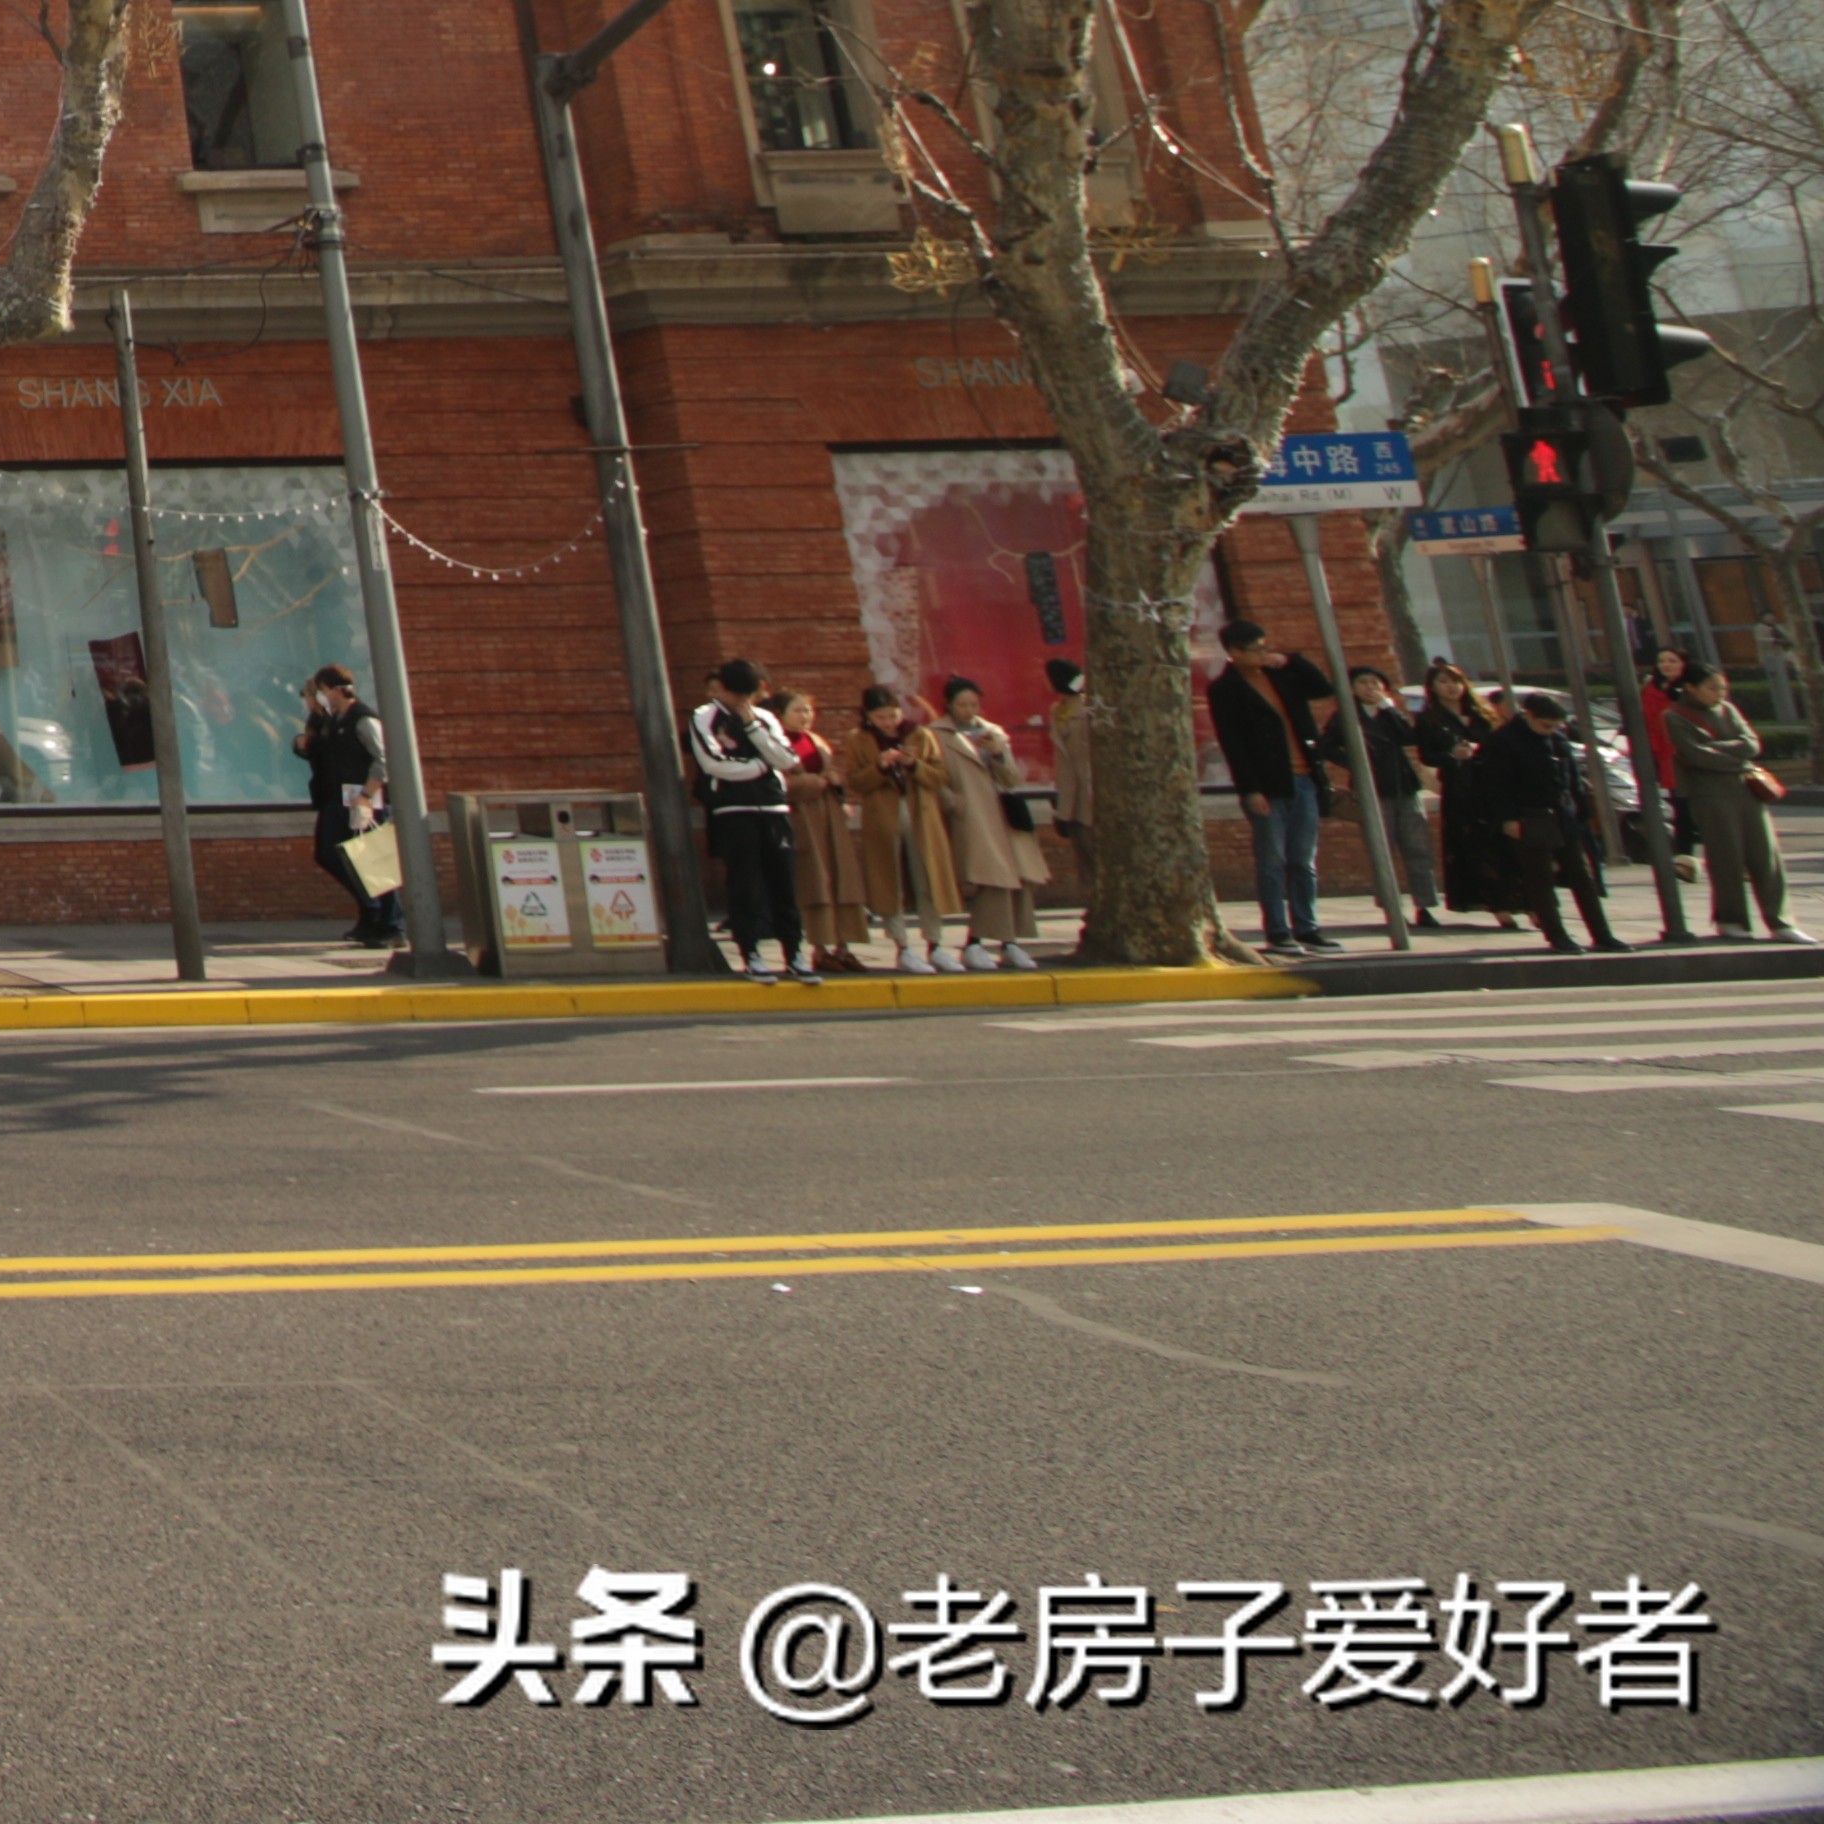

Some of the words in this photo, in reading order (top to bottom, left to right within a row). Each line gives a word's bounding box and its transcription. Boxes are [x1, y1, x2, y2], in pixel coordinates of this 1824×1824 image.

[161, 378, 223, 407] XIA
[1260, 444, 1360, 477] 海中路
[1373, 441, 1393, 460] 西
[1382, 486, 1402, 500] W
